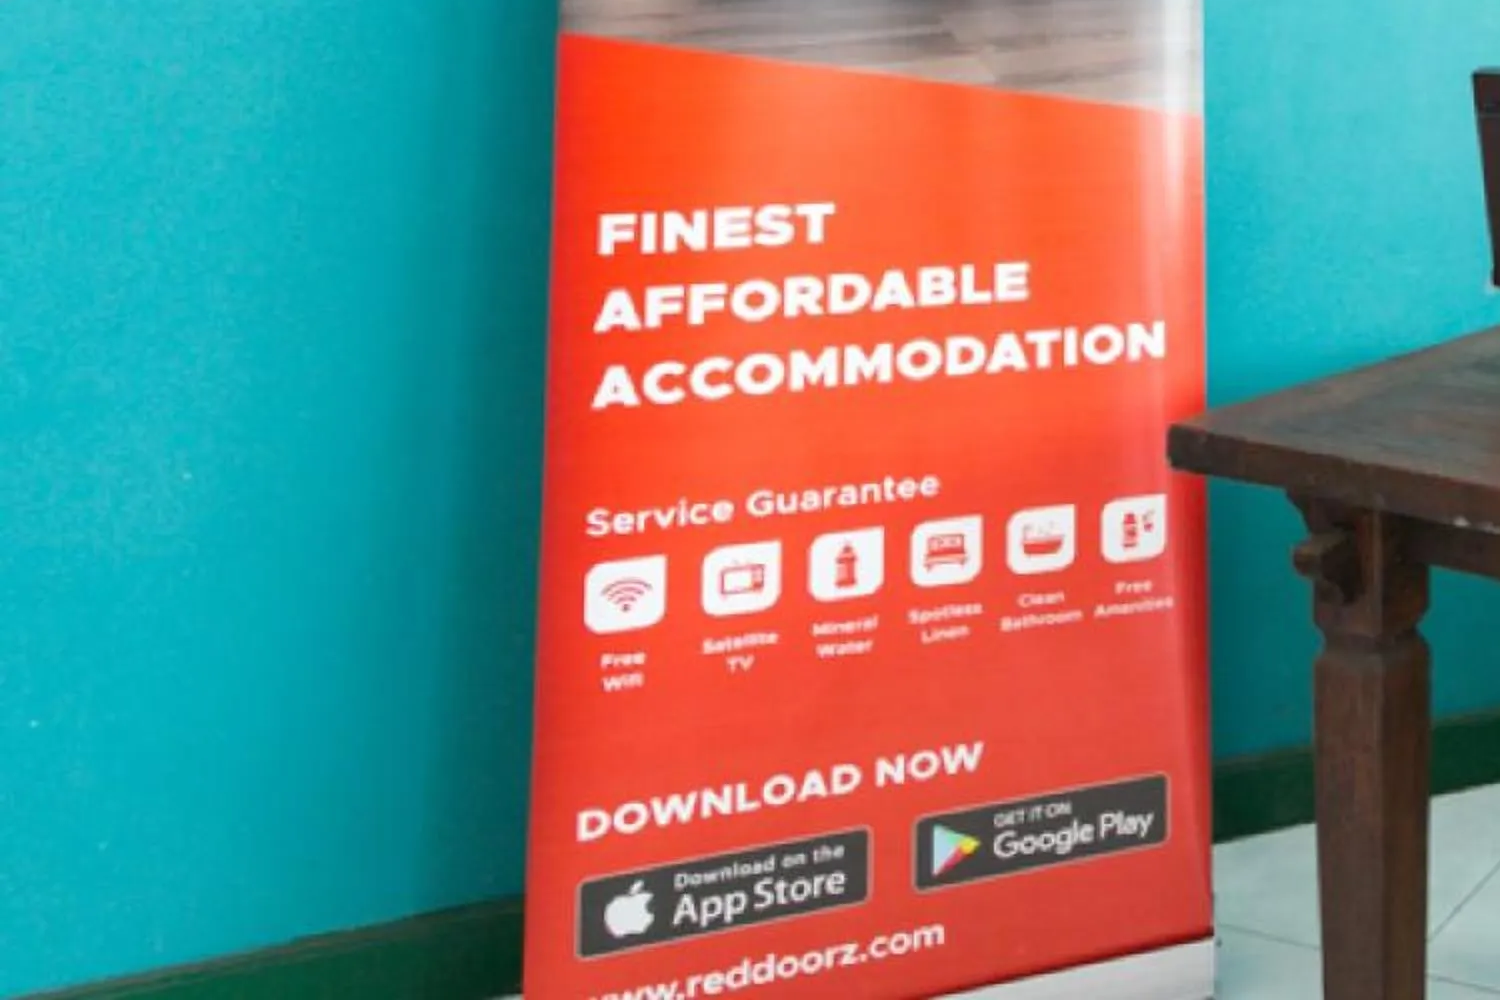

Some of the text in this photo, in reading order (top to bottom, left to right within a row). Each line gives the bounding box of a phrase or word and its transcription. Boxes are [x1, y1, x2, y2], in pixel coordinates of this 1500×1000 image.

[597, 202, 836, 255] FINEST
[592, 262, 1030, 333] AFFORDABLE
[591, 320, 1168, 409] ACCOMMODATION
[585, 474, 942, 537] Service Guarantee
[727, 656, 755, 673] TV
[576, 741, 984, 842] DOWNLOAD NOW
[994, 810, 1025, 828] GET
[1048, 801, 1072, 818] ON
[993, 809, 1154, 858] Google Play
[674, 844, 845, 891] Download on the
[672, 870, 847, 927] App Store
